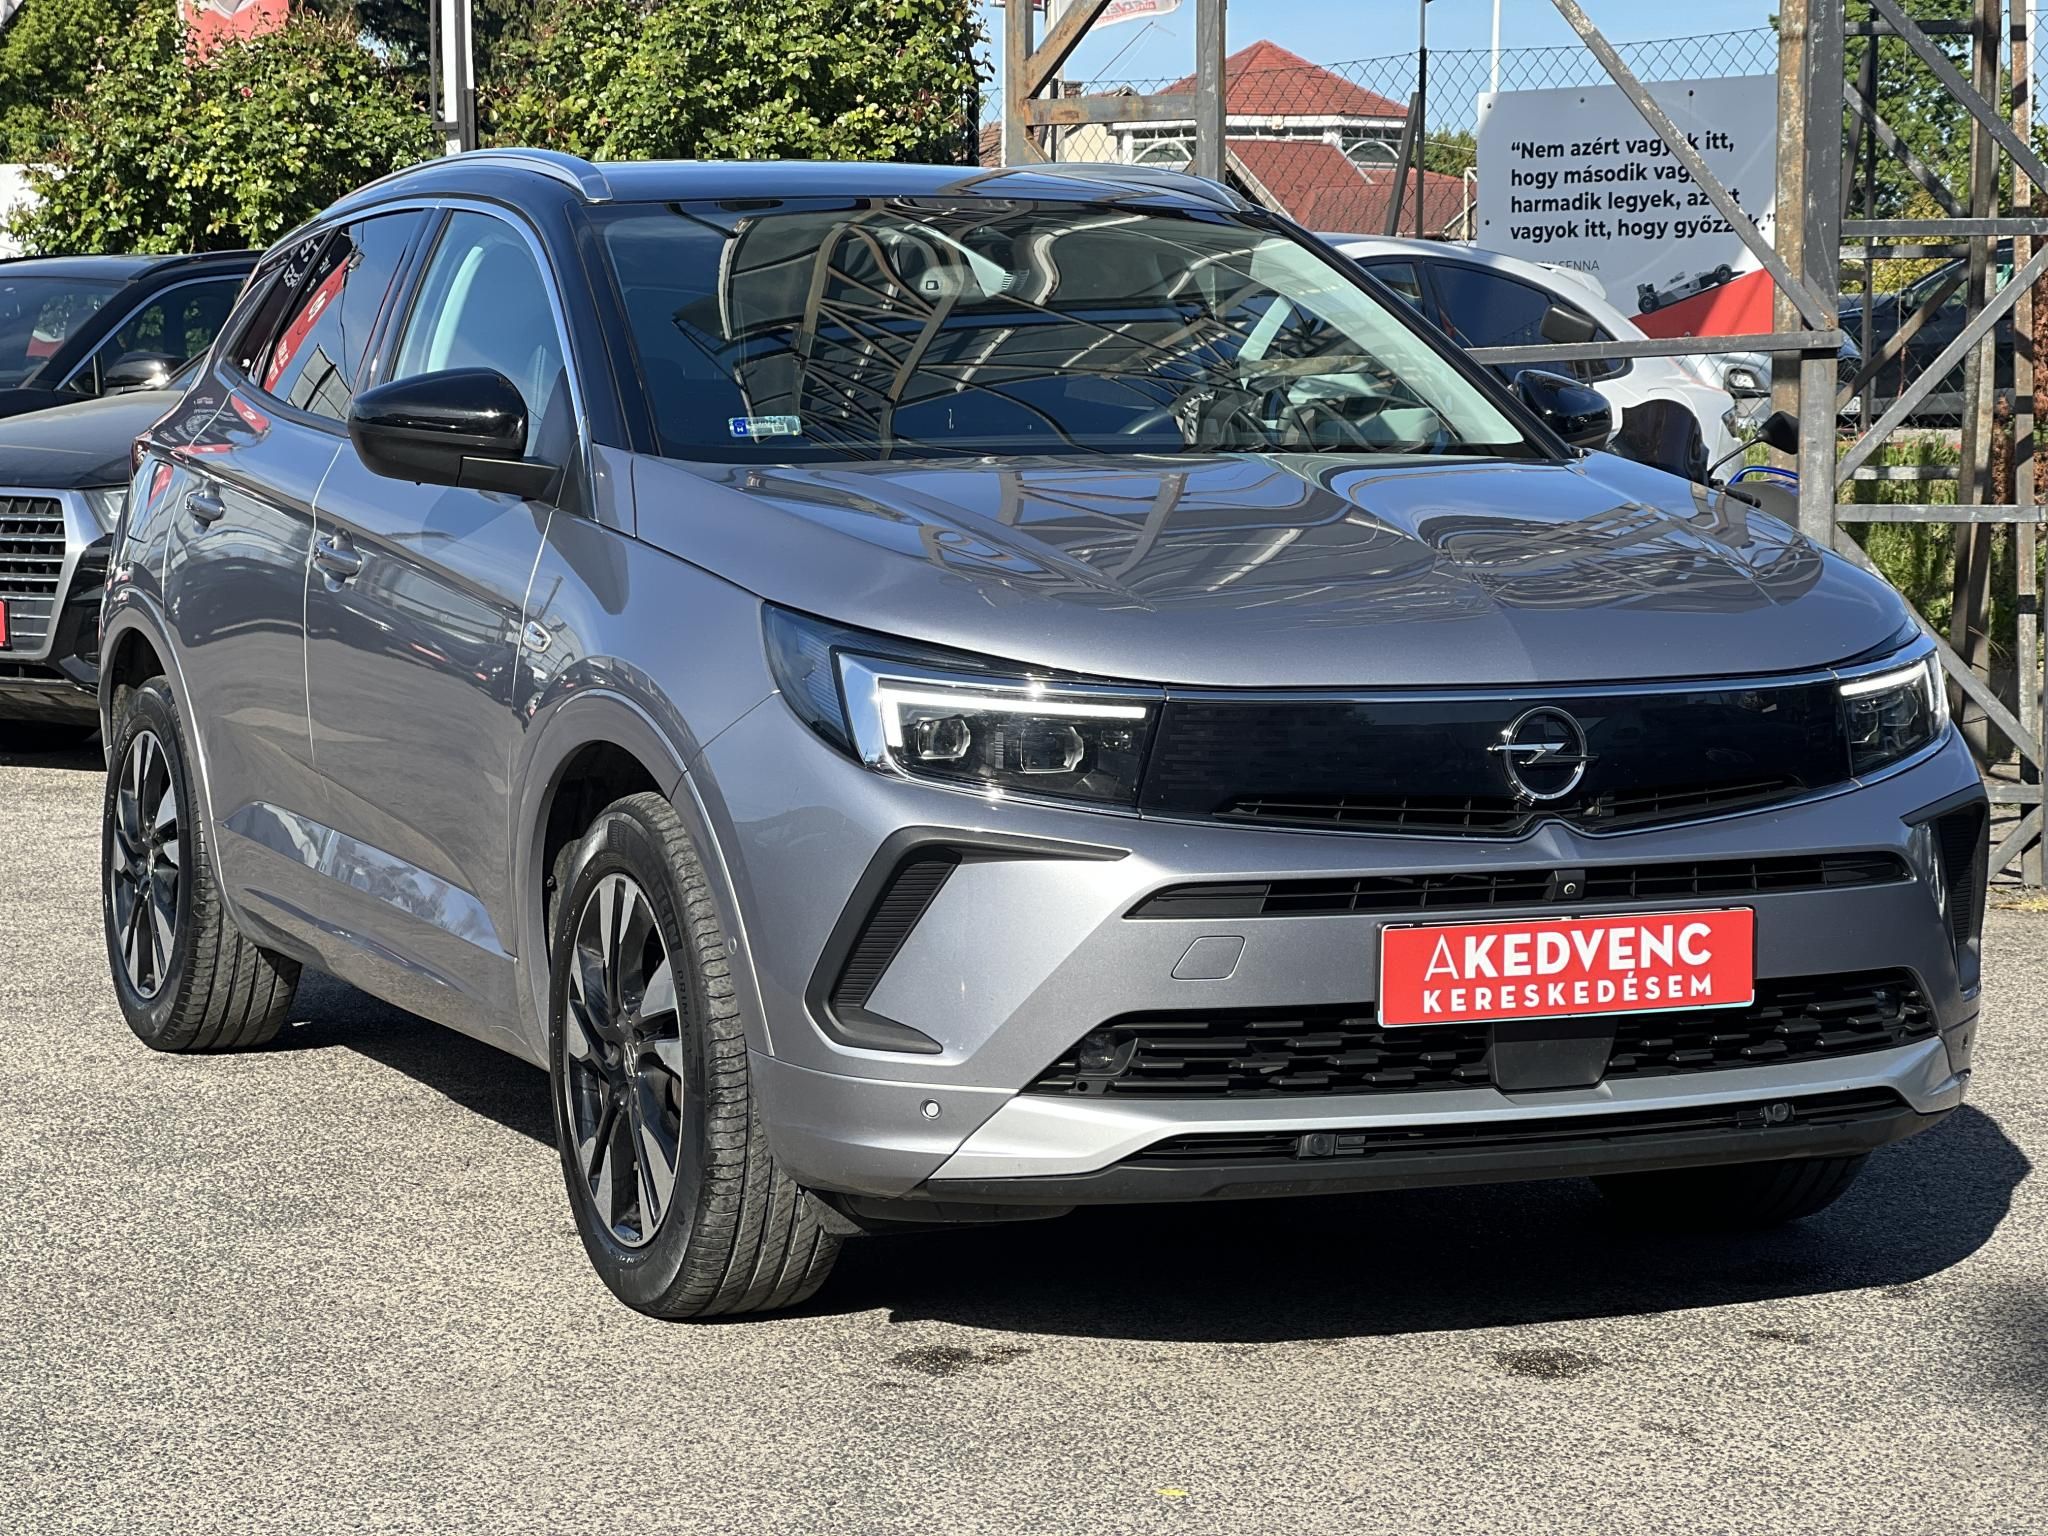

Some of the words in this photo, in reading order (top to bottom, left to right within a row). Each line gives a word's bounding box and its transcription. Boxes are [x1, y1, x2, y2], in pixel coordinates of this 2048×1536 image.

[1570, 137, 1619, 156] azért
[1626, 133, 1699, 157] vagyk
[1706, 131, 1734, 152] itt,
[1511, 169, 1558, 189] hogy
[1564, 162, 1648, 184] második
[1654, 165, 1696, 184] vag
[1511, 193, 1602, 213] harmadik
[1608, 189, 1680, 213] legyek,
[1687, 188, 1739, 206] azt
[1510, 220, 1579, 243] vagyok
[1585, 219, 1611, 240] itt,
[1618, 219, 1668, 240] hogy
[1423, 971, 1713, 1014] KERESKEDÉSEM
